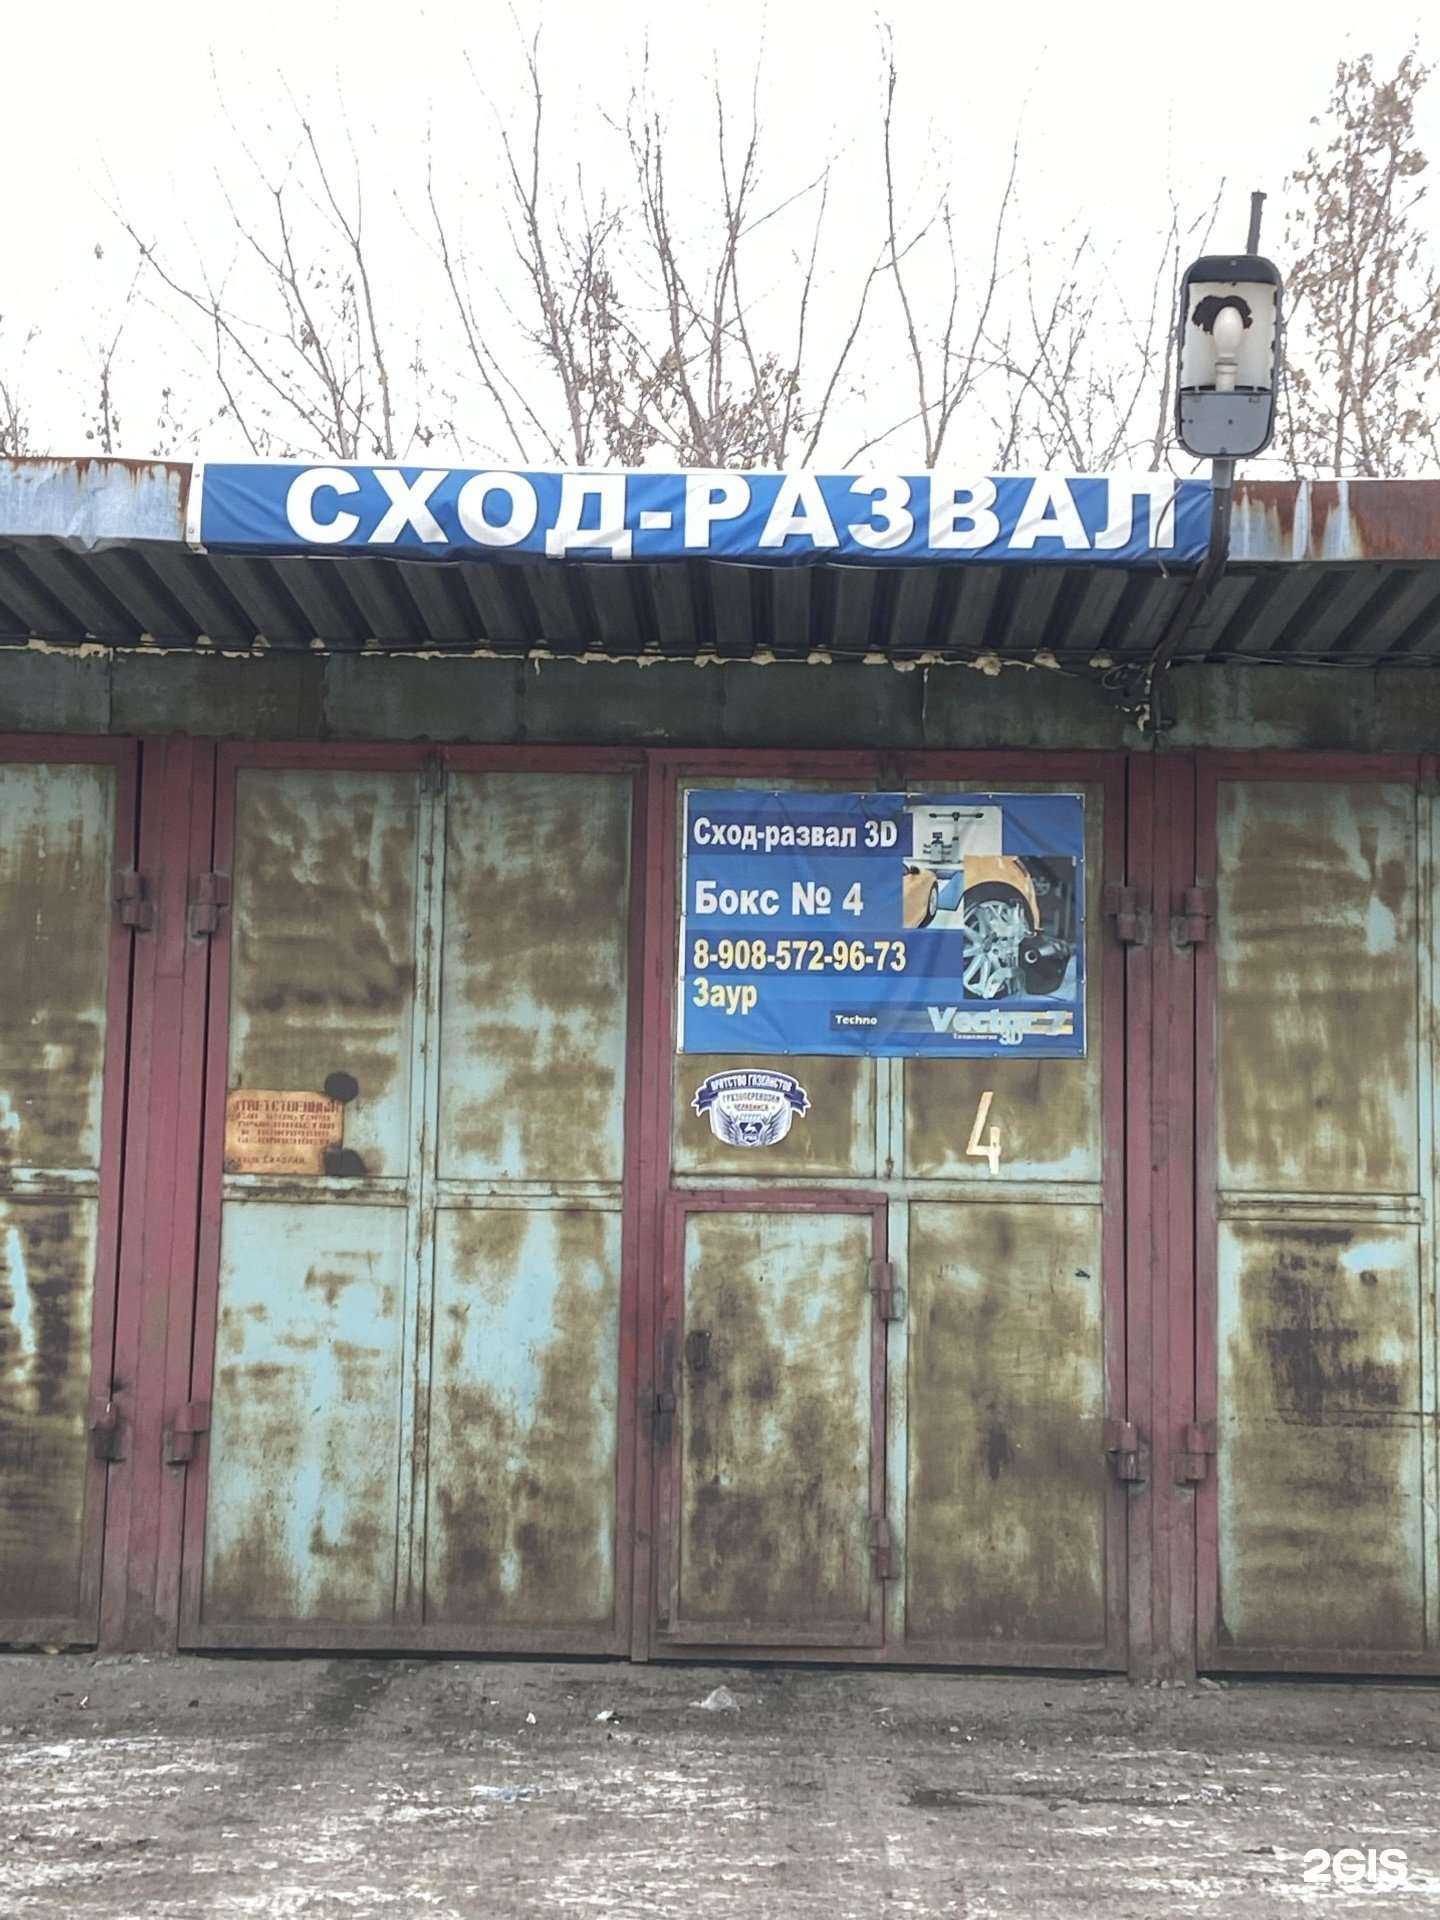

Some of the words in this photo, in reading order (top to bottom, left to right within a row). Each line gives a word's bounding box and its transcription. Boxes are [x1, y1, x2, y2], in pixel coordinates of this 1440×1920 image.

[285, 467, 1176, 561] СХОД-РАЗВАЛ
[693, 817, 857, 852] Сход-развал
[864, 820, 898, 848] 3D
[695, 880, 780, 915] Бокс
[791, 881, 831, 916] №
[842, 882, 864, 916] 4
[693, 939, 906, 971] 8-908-572-96-73
[692, 976, 758, 1015] Заур
[835, 1014, 878, 1025] Techno
[966, 1091, 1001, 1175] 4
